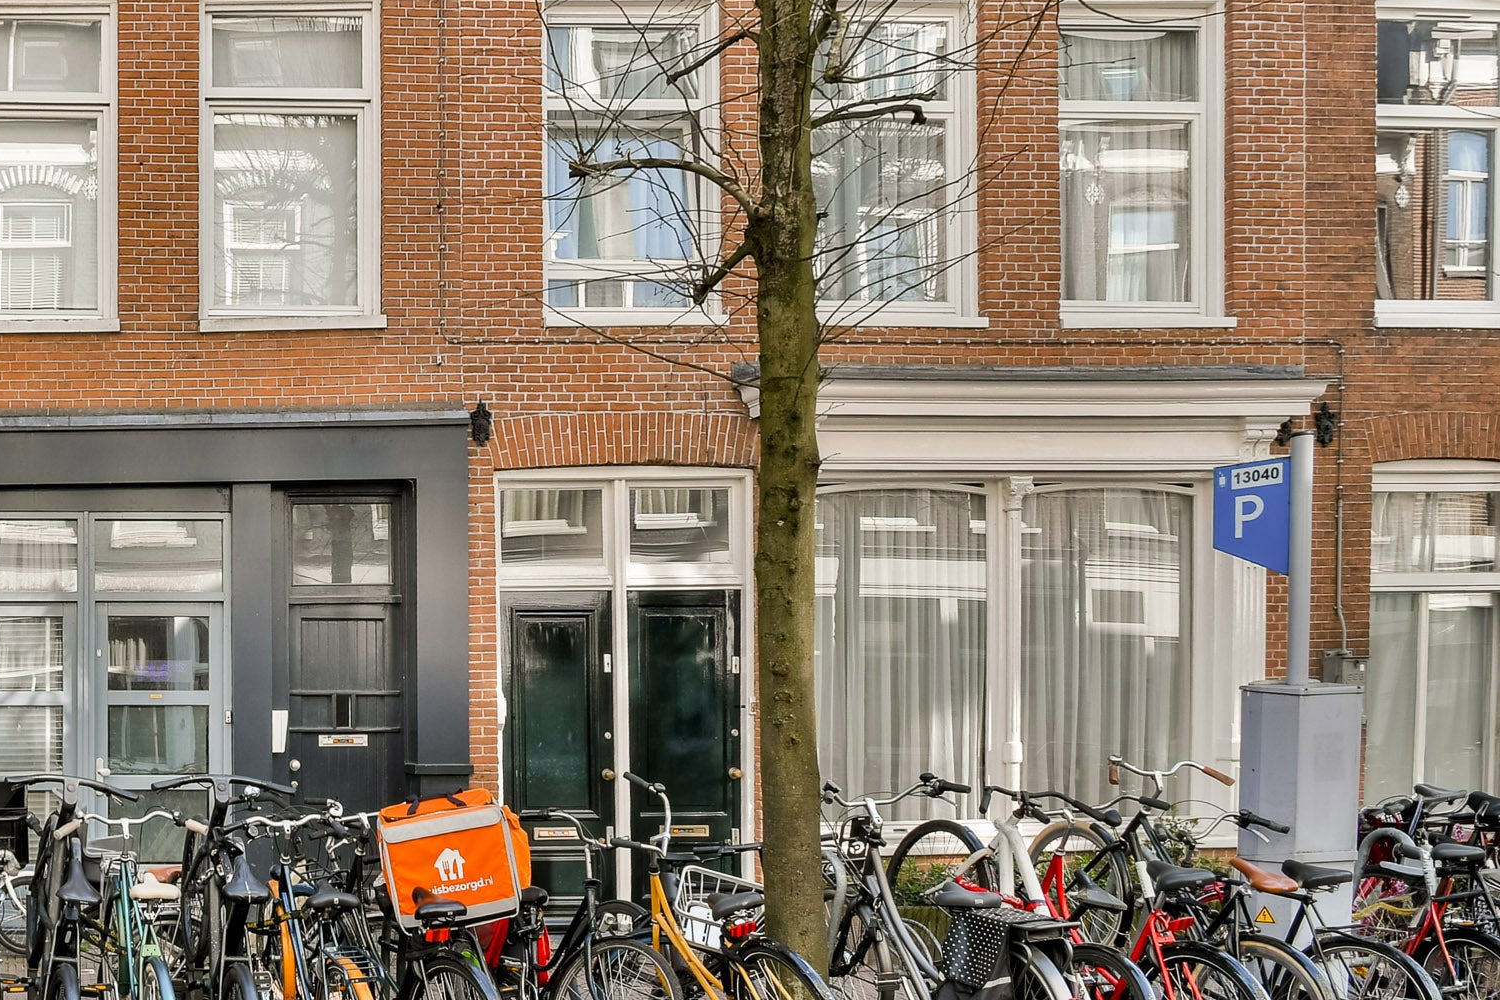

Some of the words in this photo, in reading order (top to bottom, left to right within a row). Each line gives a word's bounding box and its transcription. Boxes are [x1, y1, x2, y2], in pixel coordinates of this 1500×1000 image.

[1233, 467, 1280, 484] 13040
[1234, 495, 1265, 539] P
[429, 876, 494, 895] uisbezorgd.nl
